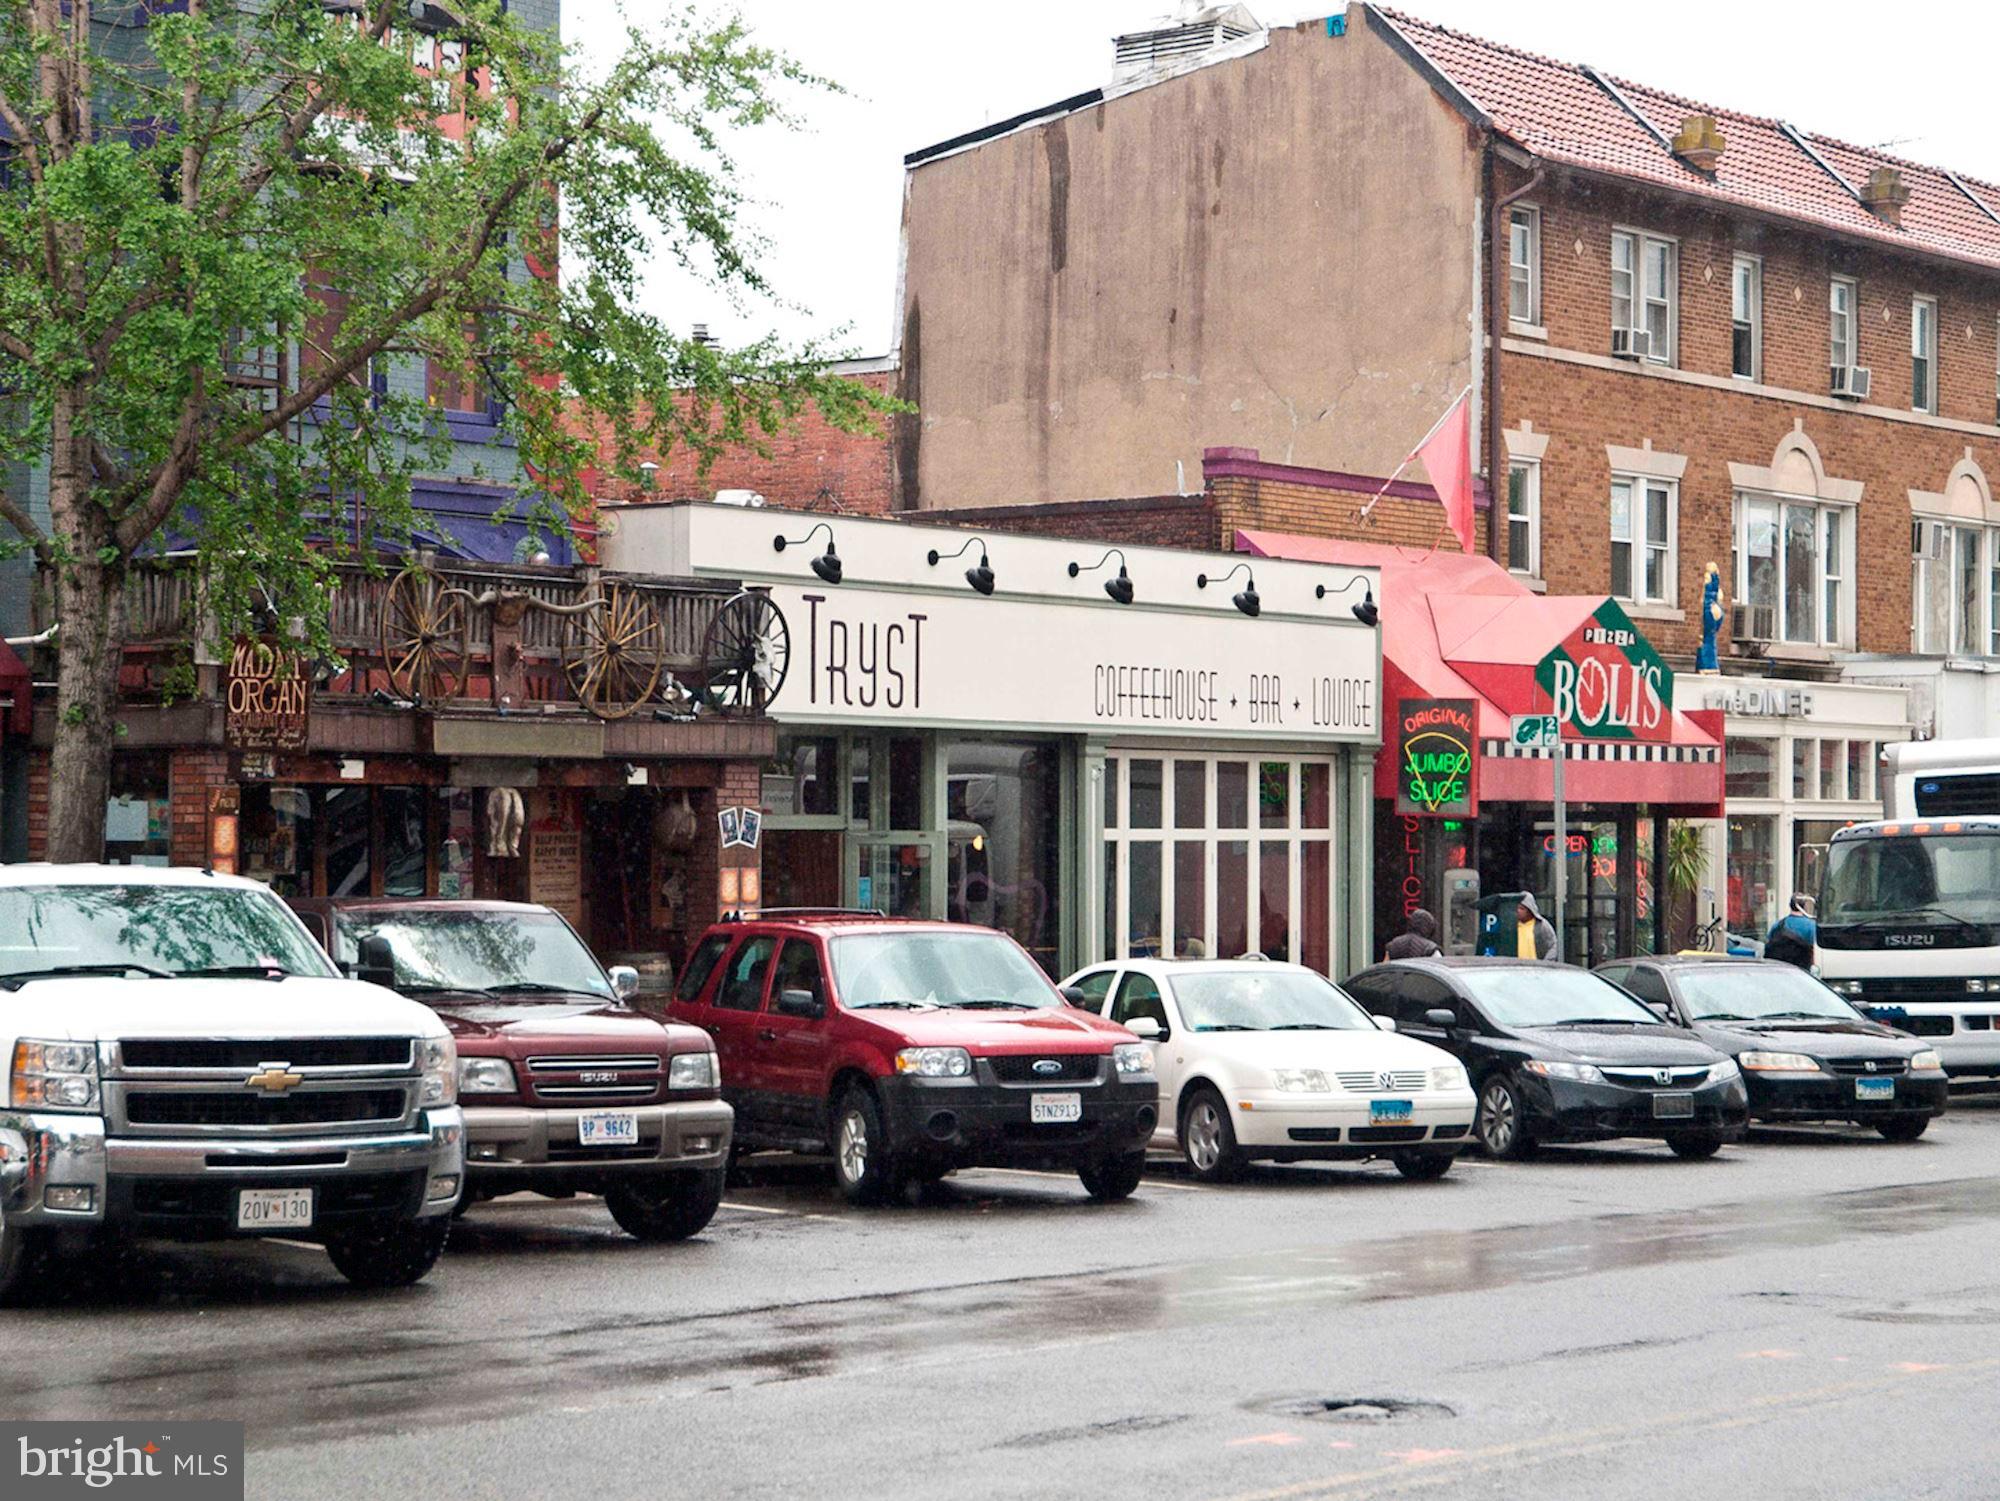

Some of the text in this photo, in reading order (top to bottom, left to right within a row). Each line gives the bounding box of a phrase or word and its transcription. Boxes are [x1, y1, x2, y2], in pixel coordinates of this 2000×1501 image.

[1585, 628, 1636, 645] PIZZA
[802, 594, 927, 709] TRYST
[227, 678, 307, 714] ORGAN
[1095, 664, 1371, 727] COFFEEHOUSE BAR LOUNGE
[1553, 656, 1662, 730] BOLI'S
[1743, 688, 1814, 716] DINER
[1404, 708, 1472, 733] ORIGINAL
[1546, 717, 1556, 729] 2
[1405, 753, 1472, 774] JUMBO
[1409, 780, 1464, 802] SLICE
[1486, 914, 1498, 931] P
[1885, 934, 1935, 947] ISUZU
[580, 1072, 618, 1083] ISUZU
[605, 1120, 631, 1136] 9642
[282, 1200, 308, 1218] 130
